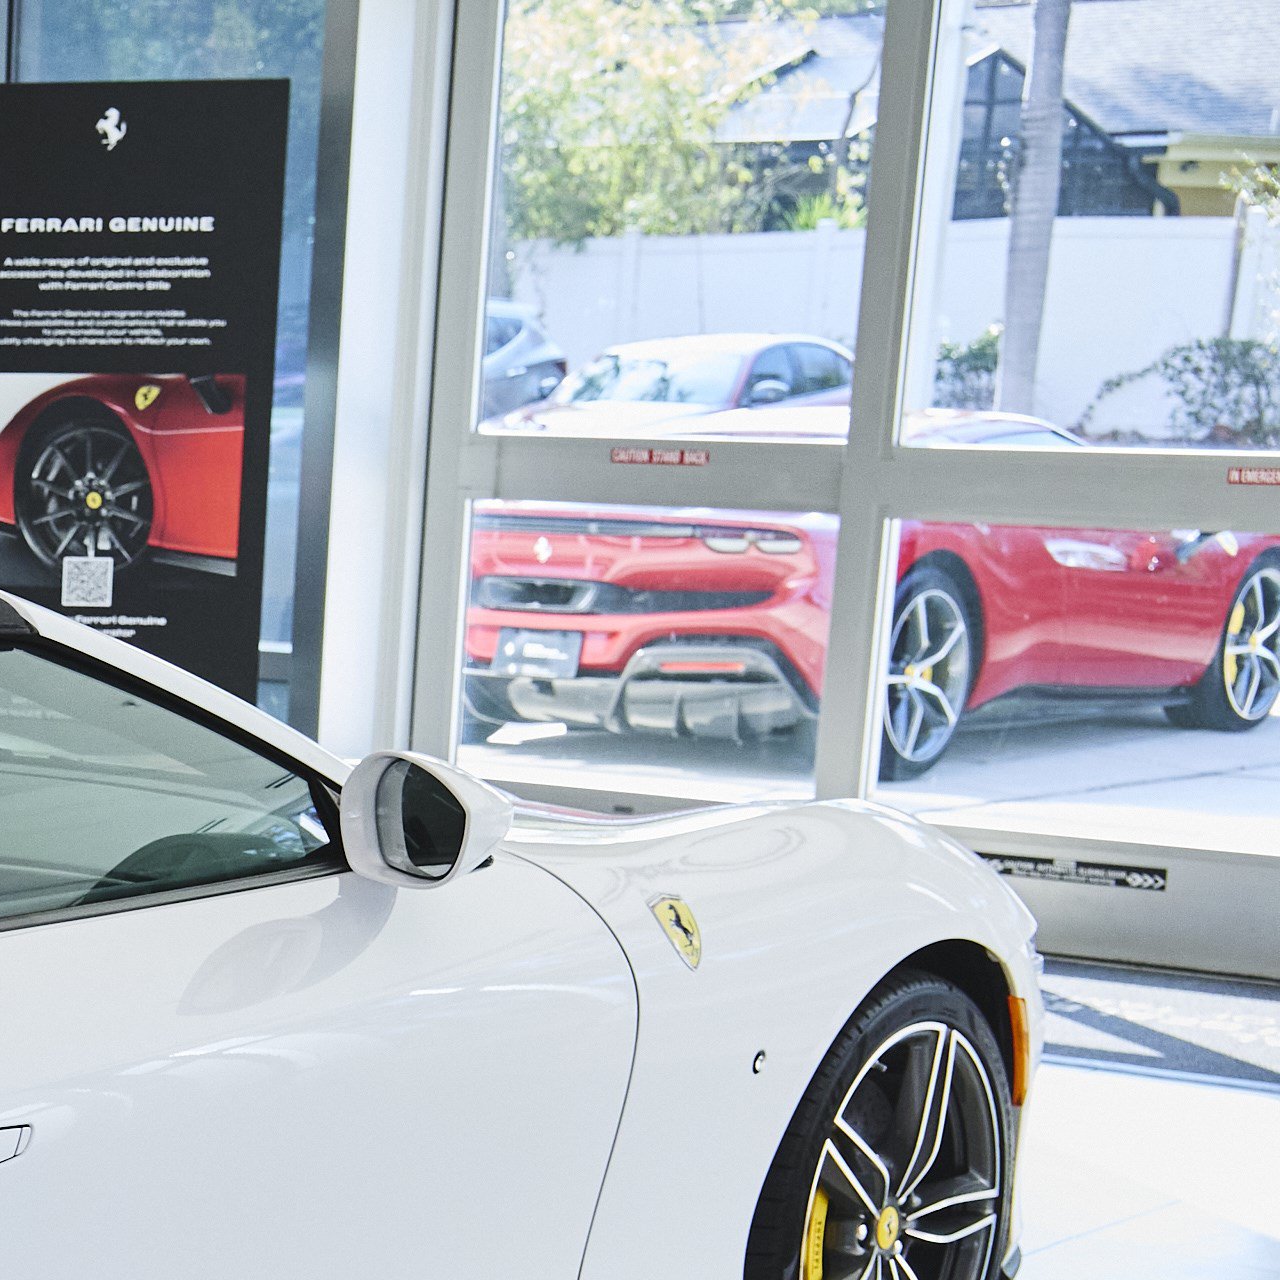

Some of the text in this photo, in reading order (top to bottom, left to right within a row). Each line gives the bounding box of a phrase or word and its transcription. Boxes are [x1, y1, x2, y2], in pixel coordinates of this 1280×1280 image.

[1, 216, 215, 233] FERRARI GENUINE
[3, 257, 13, 267] A
[41, 258, 75, 269] range
[76, 256, 89, 267] of
[90, 256, 132, 268] original
[133, 256, 155, 267] and
[38, 281, 64, 291] with
[64, 281, 104, 291] Ferrari
[105, 281, 145, 291] Centro
[118, 615, 168, 626] Genuine
